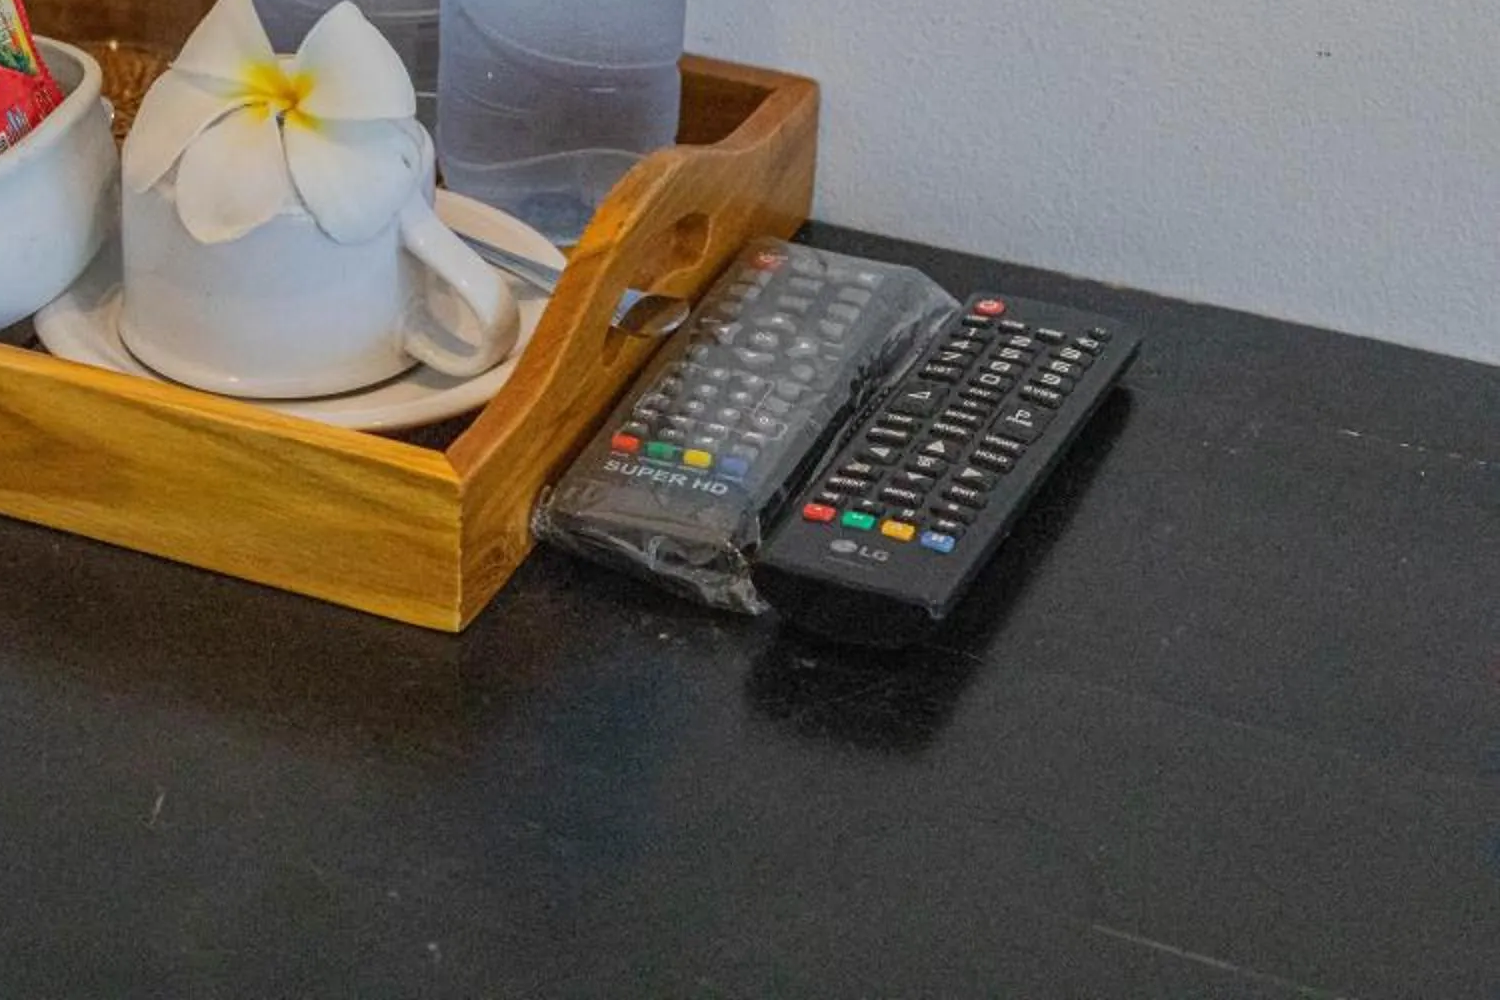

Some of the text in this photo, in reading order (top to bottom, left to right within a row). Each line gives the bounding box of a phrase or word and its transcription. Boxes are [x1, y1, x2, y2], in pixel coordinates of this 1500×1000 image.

[979, 373, 1001, 386] 0
[602, 458, 689, 487] SUPER
[691, 477, 730, 497] HD
[859, 544, 890, 562] LG
